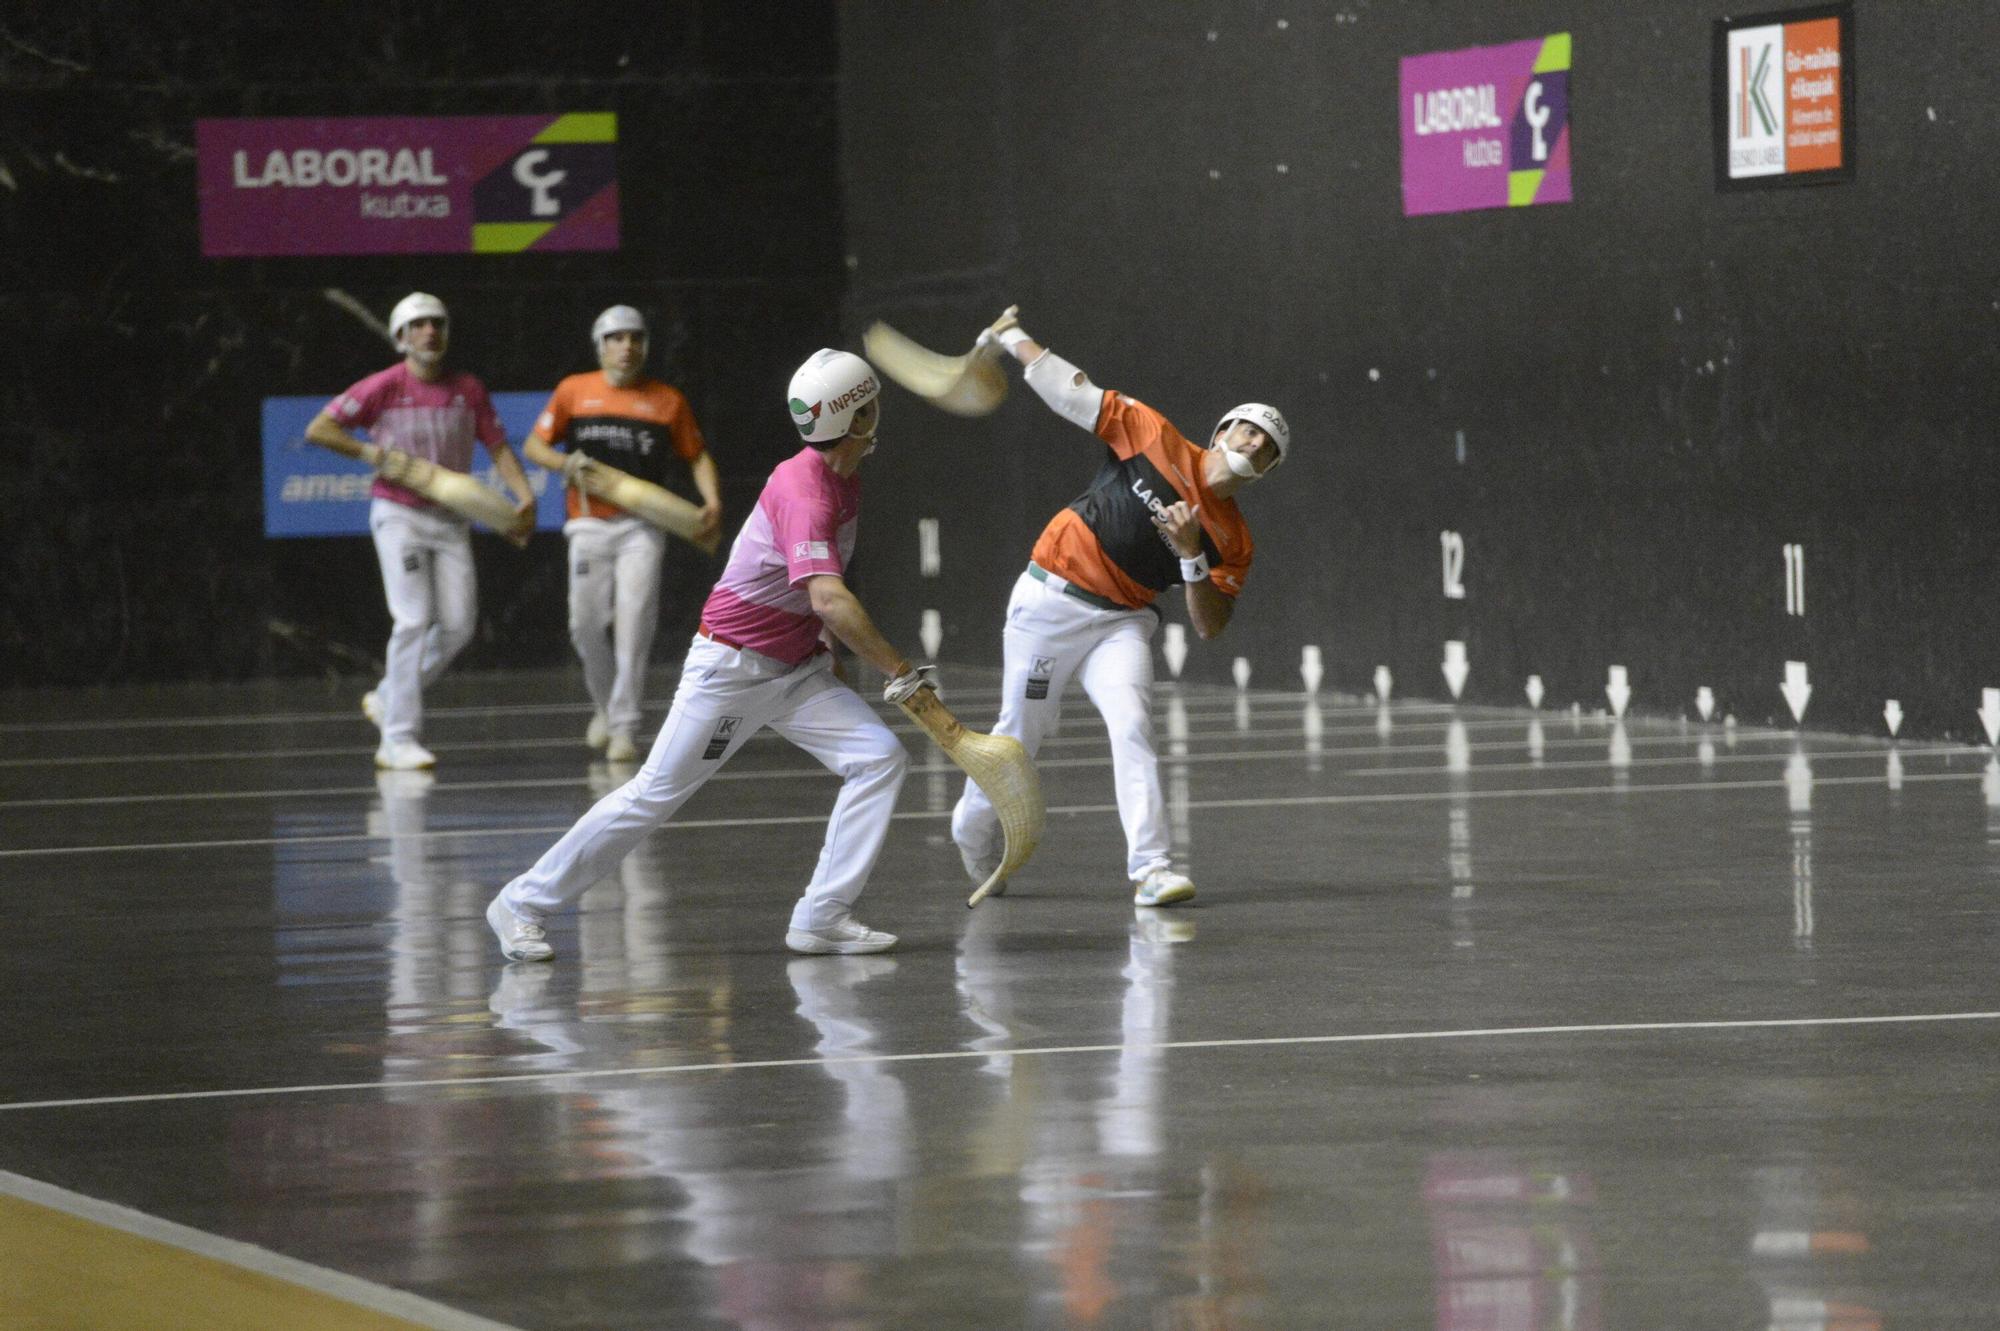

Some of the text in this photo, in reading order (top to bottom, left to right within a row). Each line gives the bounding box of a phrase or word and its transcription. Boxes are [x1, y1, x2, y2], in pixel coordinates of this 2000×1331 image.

[1414, 83, 1502, 136] LABORAL
[233, 147, 448, 188] LABORAL
[361, 192, 451, 219] kutxa
[1440, 530, 1466, 599] 12
[1783, 543, 1804, 615] 11
